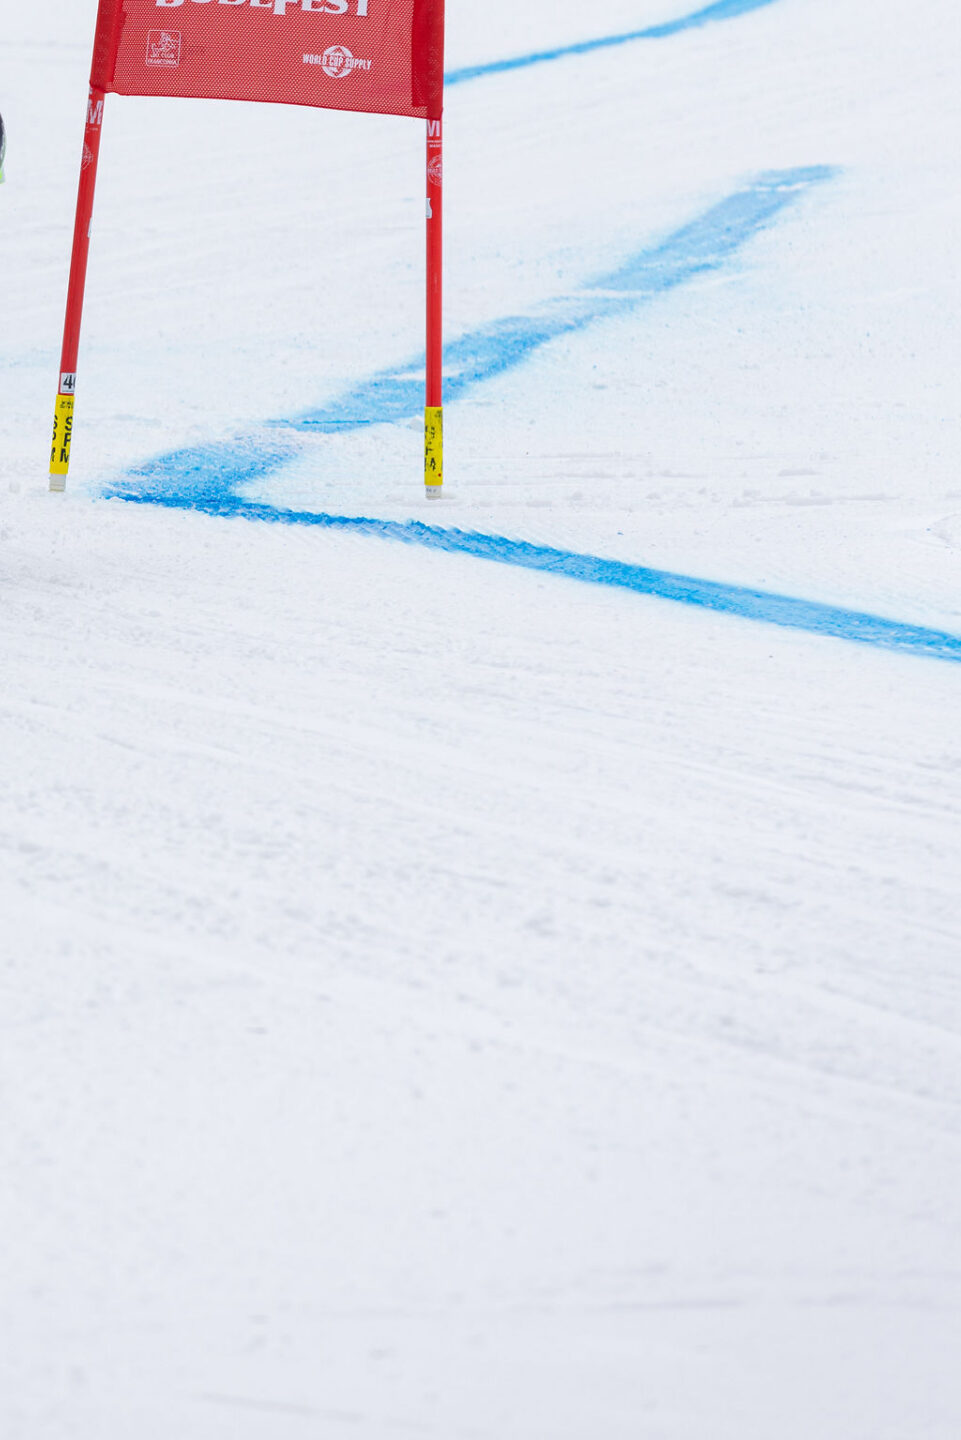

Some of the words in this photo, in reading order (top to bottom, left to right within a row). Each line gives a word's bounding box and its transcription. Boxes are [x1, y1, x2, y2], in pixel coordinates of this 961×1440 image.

[303, 53, 327, 66] WORLD
[329, 55, 343, 67] CUP
[345, 57, 372, 70] SUPPLY
